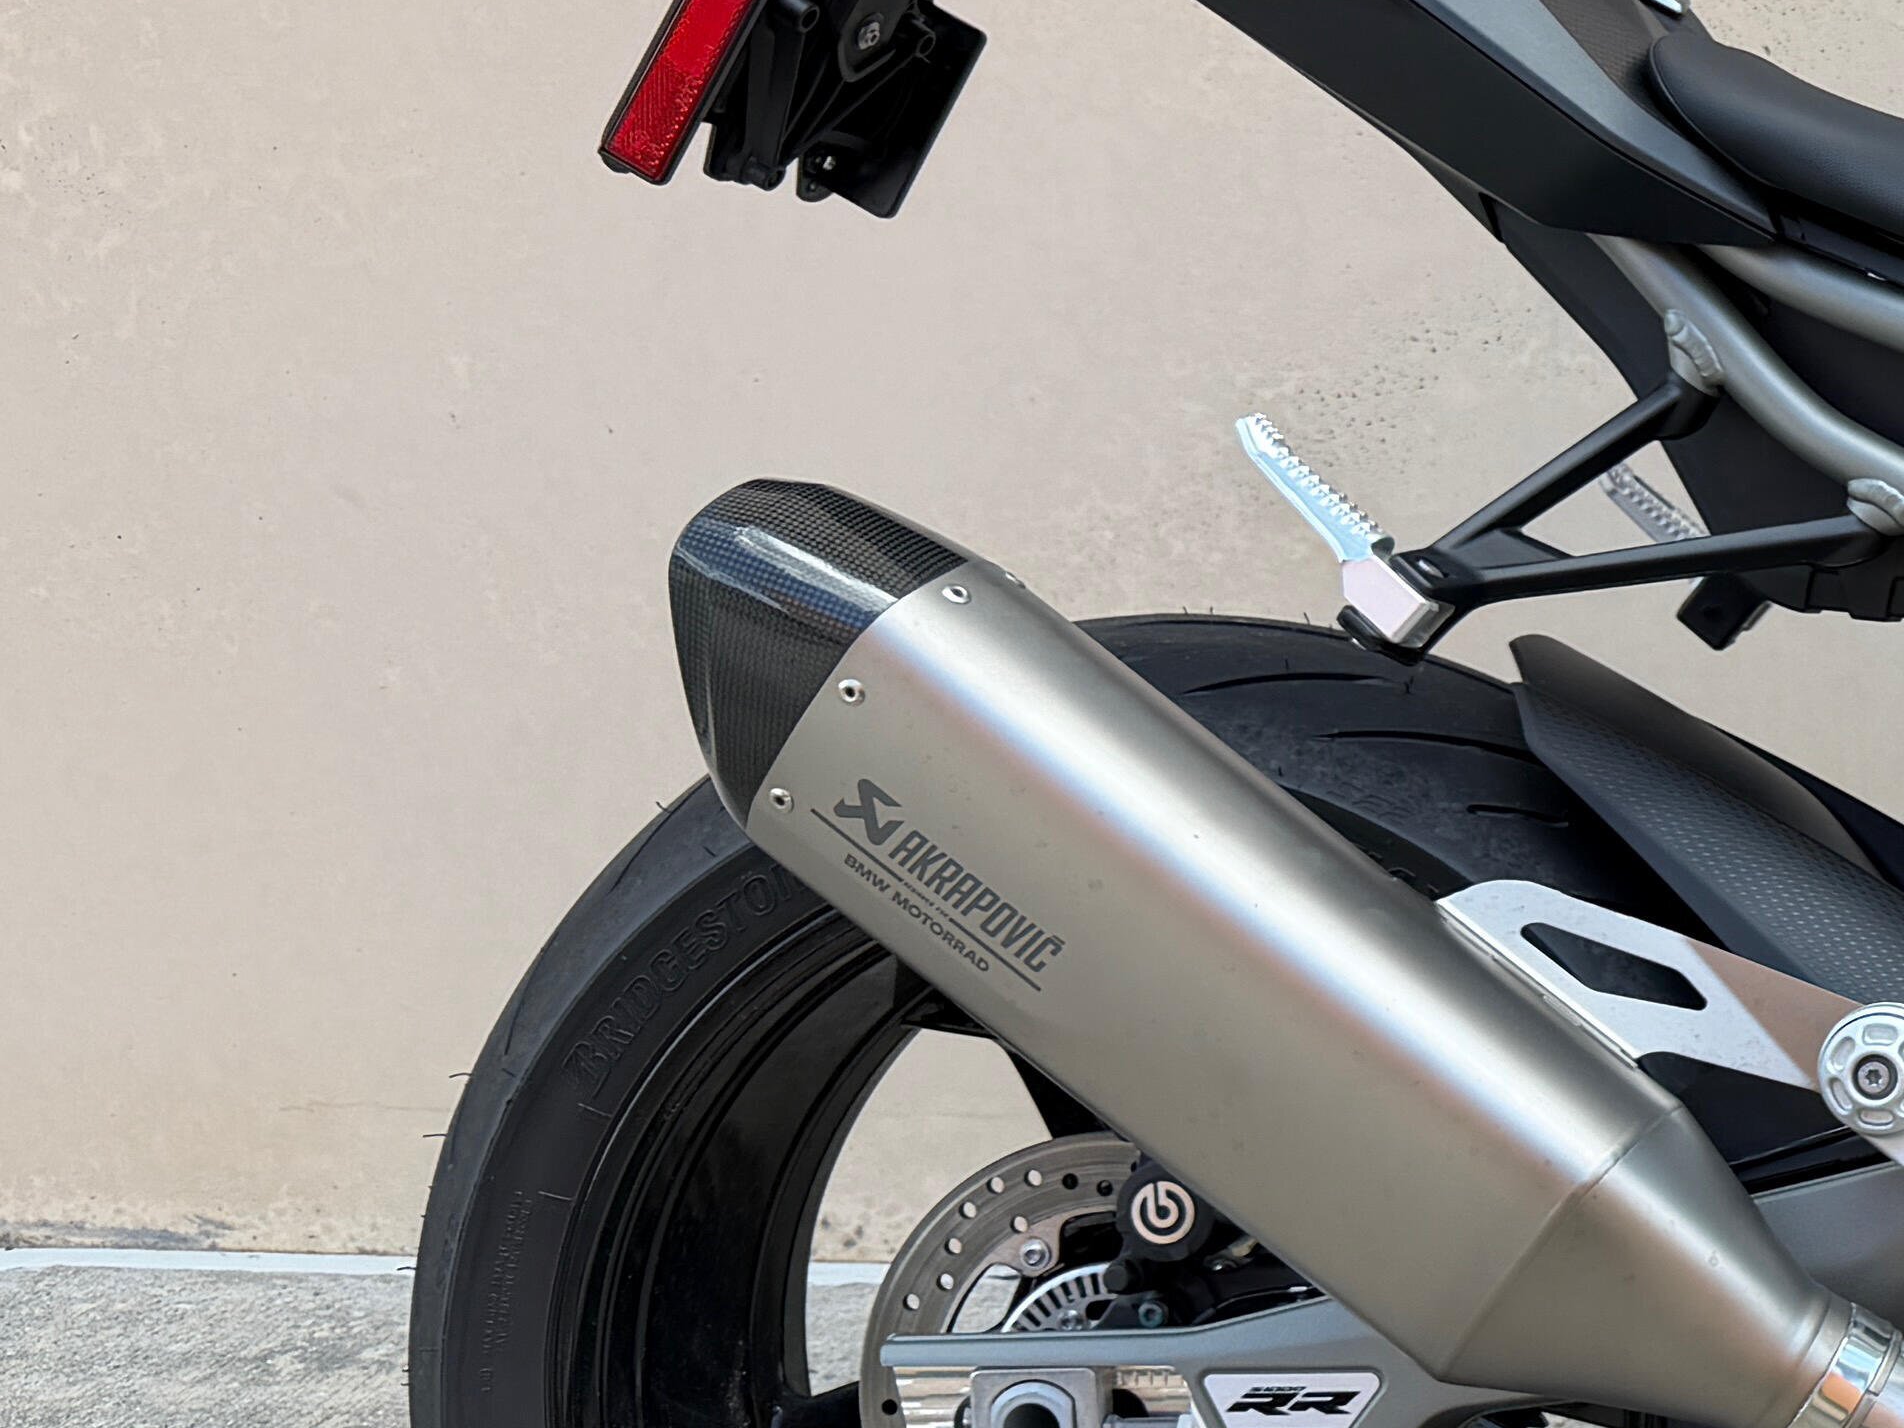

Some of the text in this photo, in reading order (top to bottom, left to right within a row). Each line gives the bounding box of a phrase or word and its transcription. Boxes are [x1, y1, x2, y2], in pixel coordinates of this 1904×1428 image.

[843, 853, 891, 893] BMW
[891, 890, 990, 973] MOTORRAD
[1225, 1391, 1361, 1416] RR
